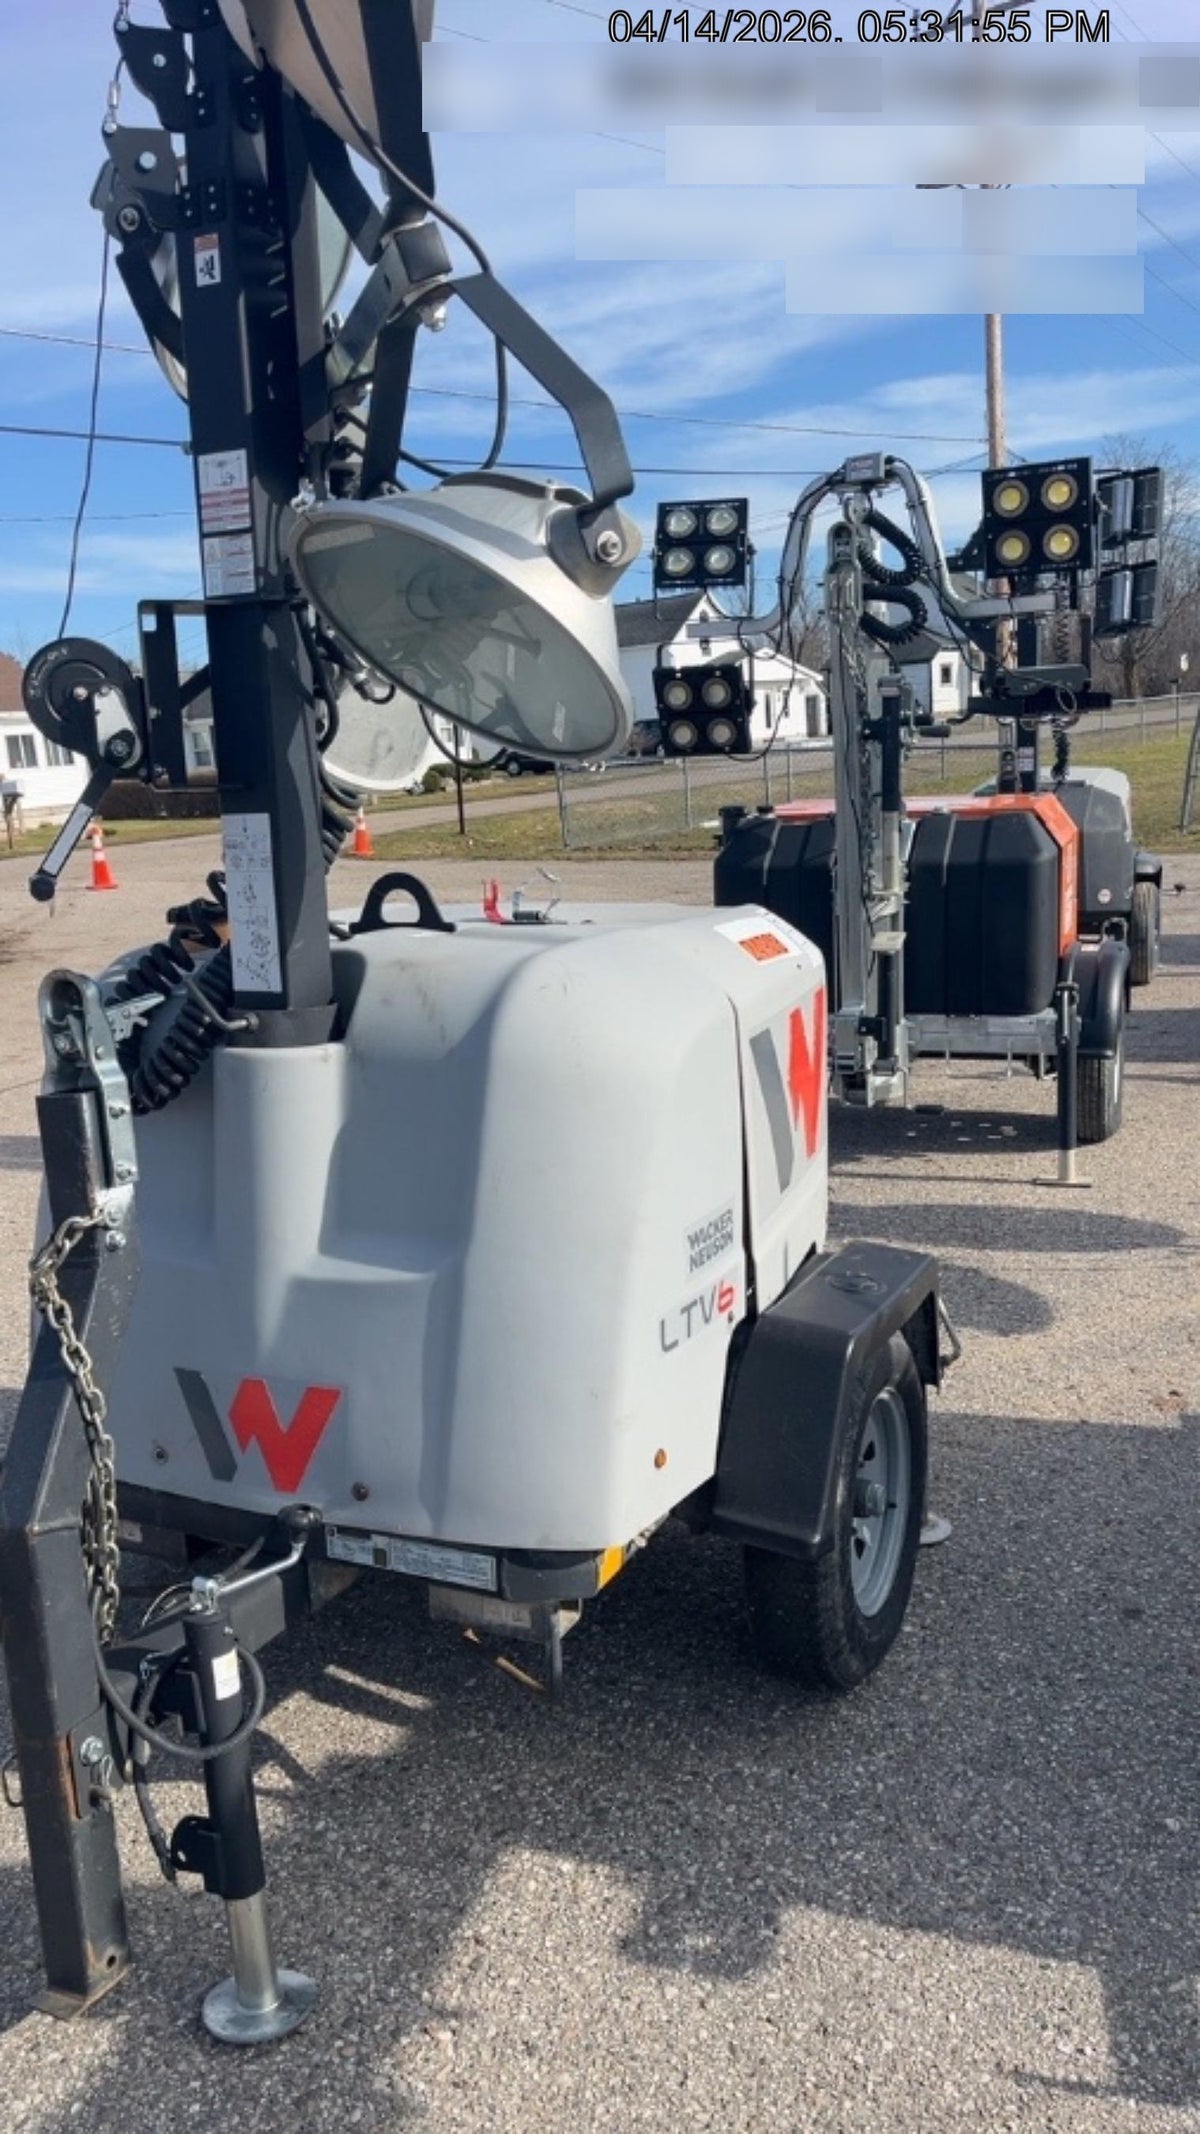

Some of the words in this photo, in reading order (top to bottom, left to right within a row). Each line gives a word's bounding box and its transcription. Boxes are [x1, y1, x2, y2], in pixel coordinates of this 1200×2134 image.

[687, 1208, 734, 1251] WACKER
[689, 1227, 734, 1273] NEUSON
[659, 1280, 734, 1353] LTV6
